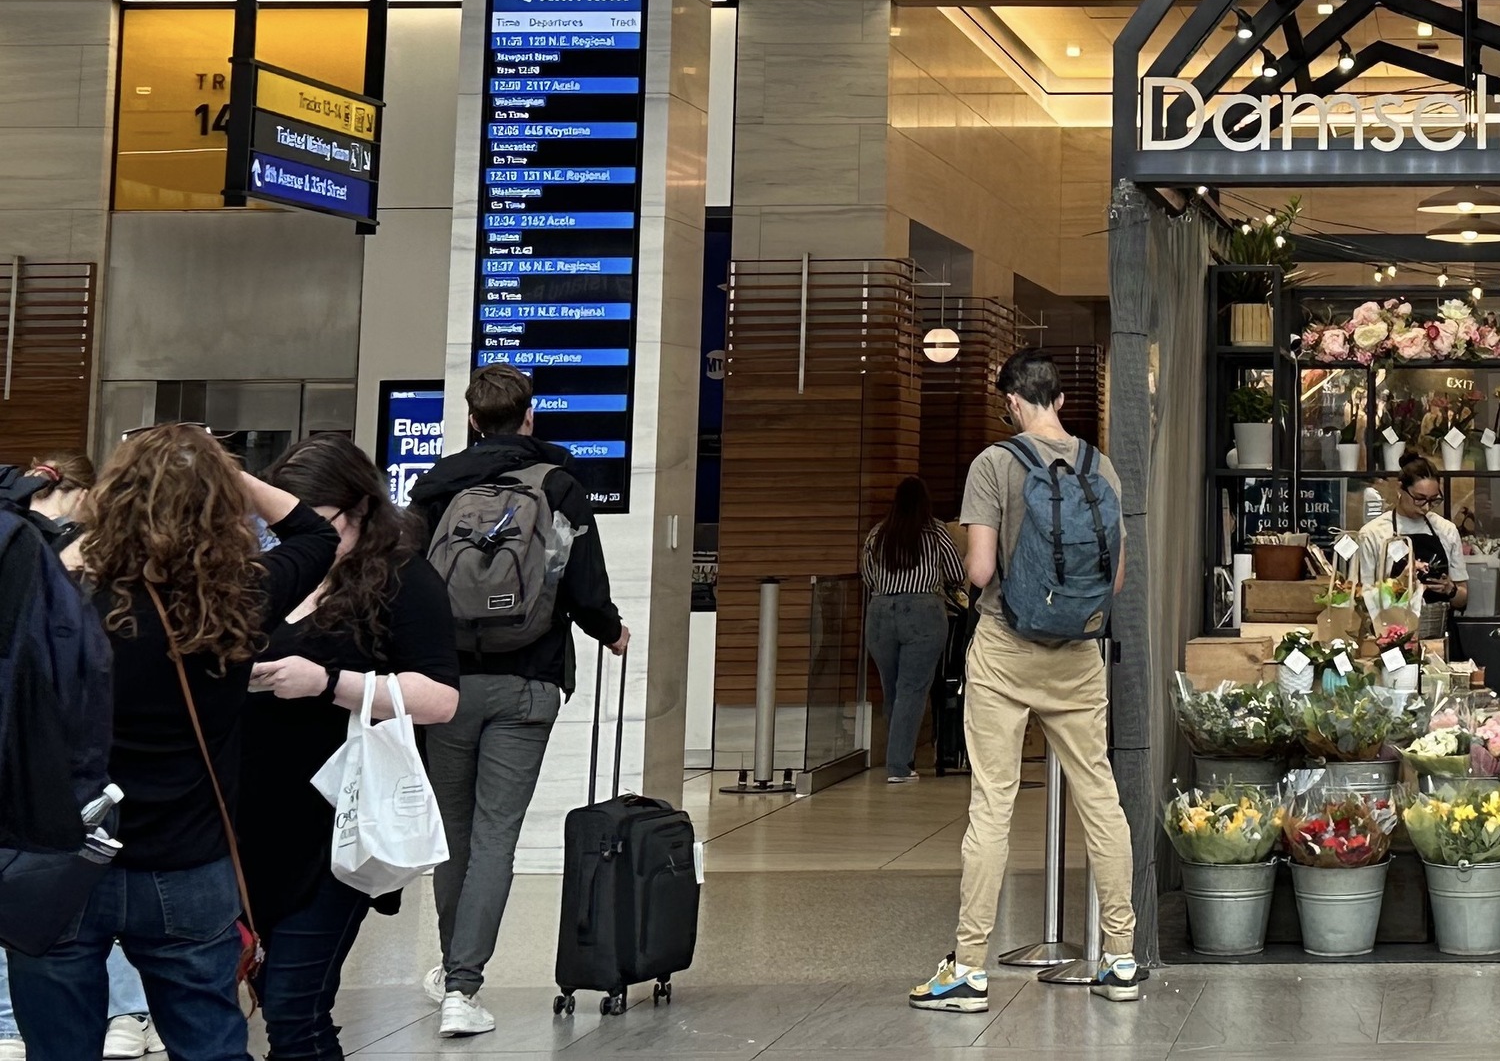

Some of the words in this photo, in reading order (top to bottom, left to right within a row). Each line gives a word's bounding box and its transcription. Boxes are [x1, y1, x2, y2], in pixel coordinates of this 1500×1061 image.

[496, 17, 520, 26] Time
[529, 17, 583, 28] Departures
[611, 17, 637, 26] Track
[572, 35, 615, 48] Regional
[527, 80, 551, 91] 2117
[552, 80, 580, 91] Acela
[495, 97, 544, 108] Washington
[495, 111, 507, 119] On
[508, 111, 529, 119] Time
[545, 125, 591, 138] Keystone
[277, 125, 305, 150] Ticketed
[306, 134, 331, 161] Waiting
[332, 141, 350, 162] Room
[494, 142, 536, 151] Lancaster
[494, 156, 505, 164] On
[507, 156, 527, 164] Time
[566, 171, 610, 183] Regional
[278, 168, 304, 189] Avenue
[327, 179, 347, 200] Street
[491, 188, 541, 198] Washington
[491, 201, 503, 209] On
[505, 201, 525, 209] Time
[547, 215, 576, 226] Acela
[489, 233, 519, 242] Boston
[557, 261, 601, 273] Regional
[487, 292, 499, 300] On
[501, 292, 522, 300] Time
[518, 307, 534, 318] 171
[561, 307, 605, 319] Regional
[485, 338, 497, 346] On
[499, 338, 520, 346] Time
[535, 352, 582, 365] Keystone
[1446, 377, 1475, 391] EXIT
[539, 398, 568, 409] Acela
[570, 444, 608, 456] Service
